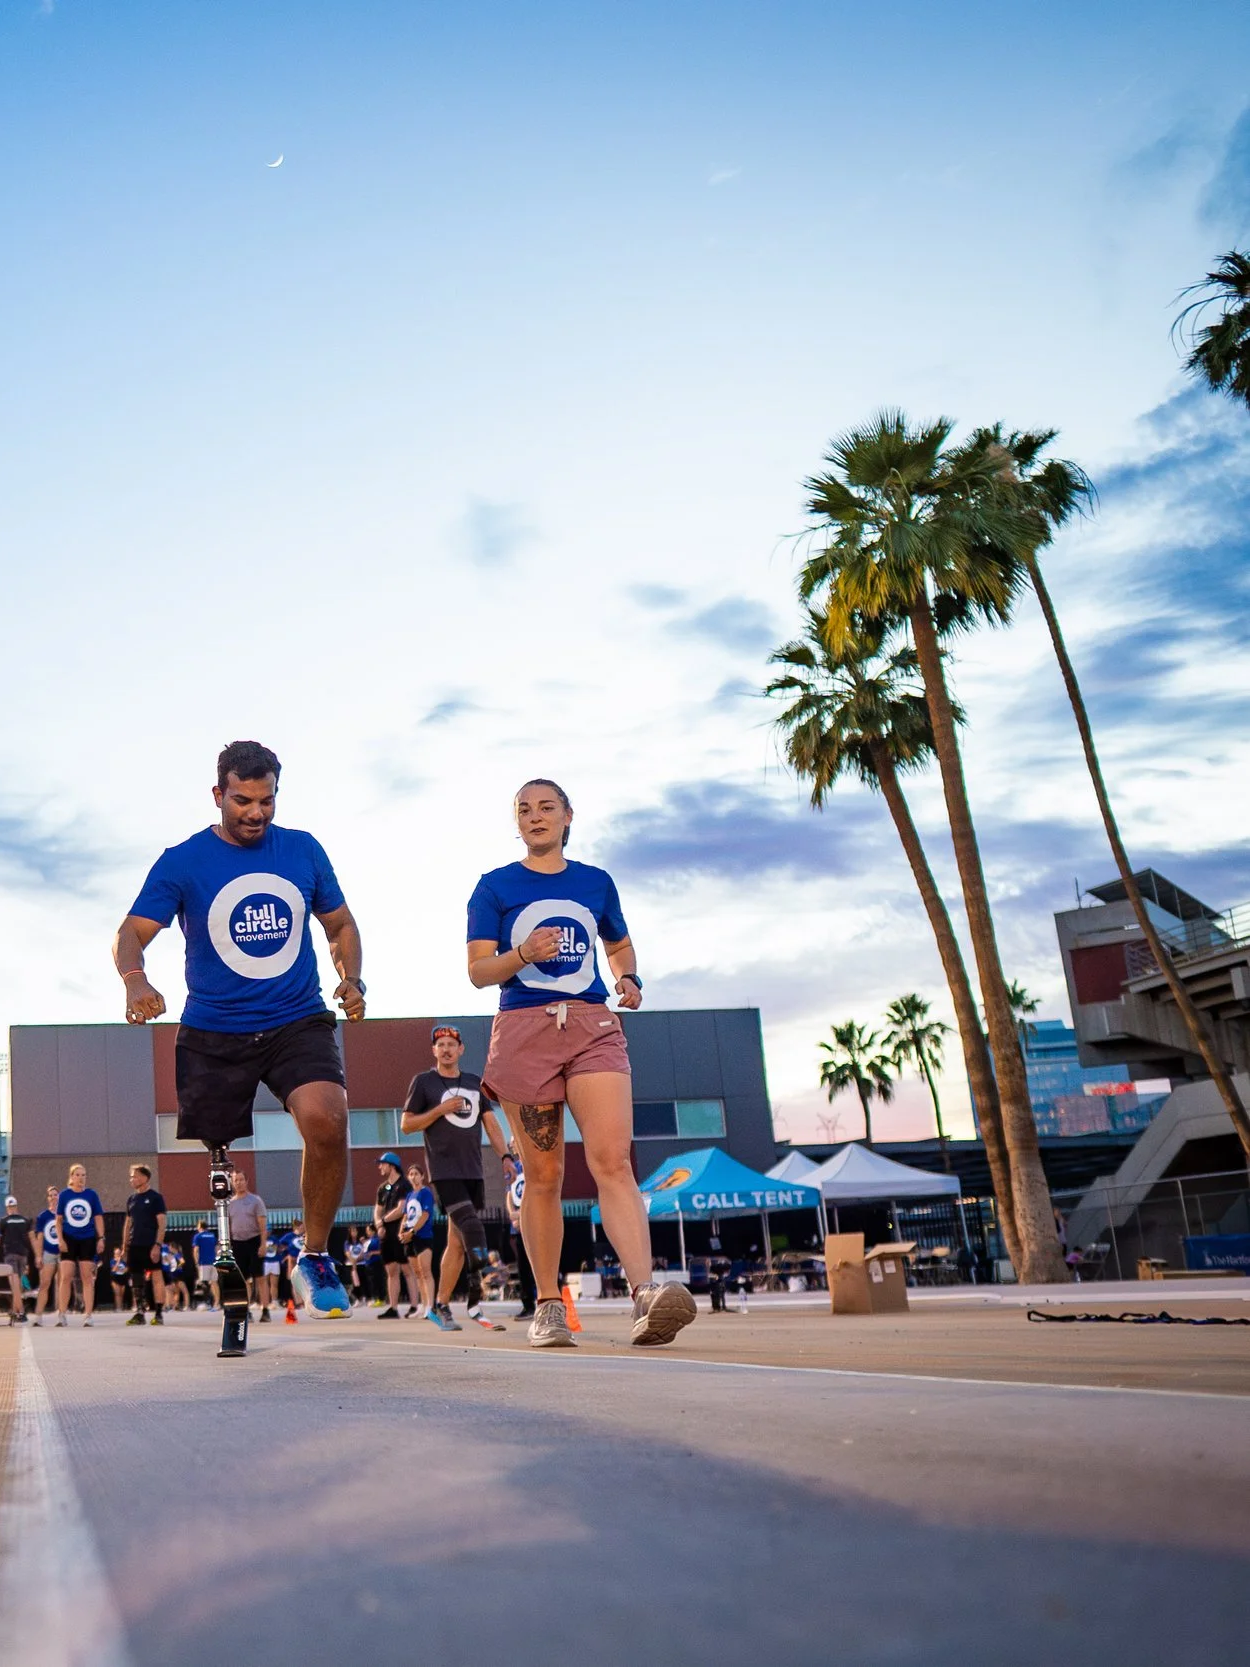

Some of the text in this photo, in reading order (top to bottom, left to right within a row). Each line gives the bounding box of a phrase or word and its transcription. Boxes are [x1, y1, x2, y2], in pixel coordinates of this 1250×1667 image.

[243, 903, 276, 921] full
[235, 917, 289, 933] circle
[235, 930, 288, 943] movement
[559, 942, 587, 954] cle
[692, 1190, 805, 1209] CALL TENT
